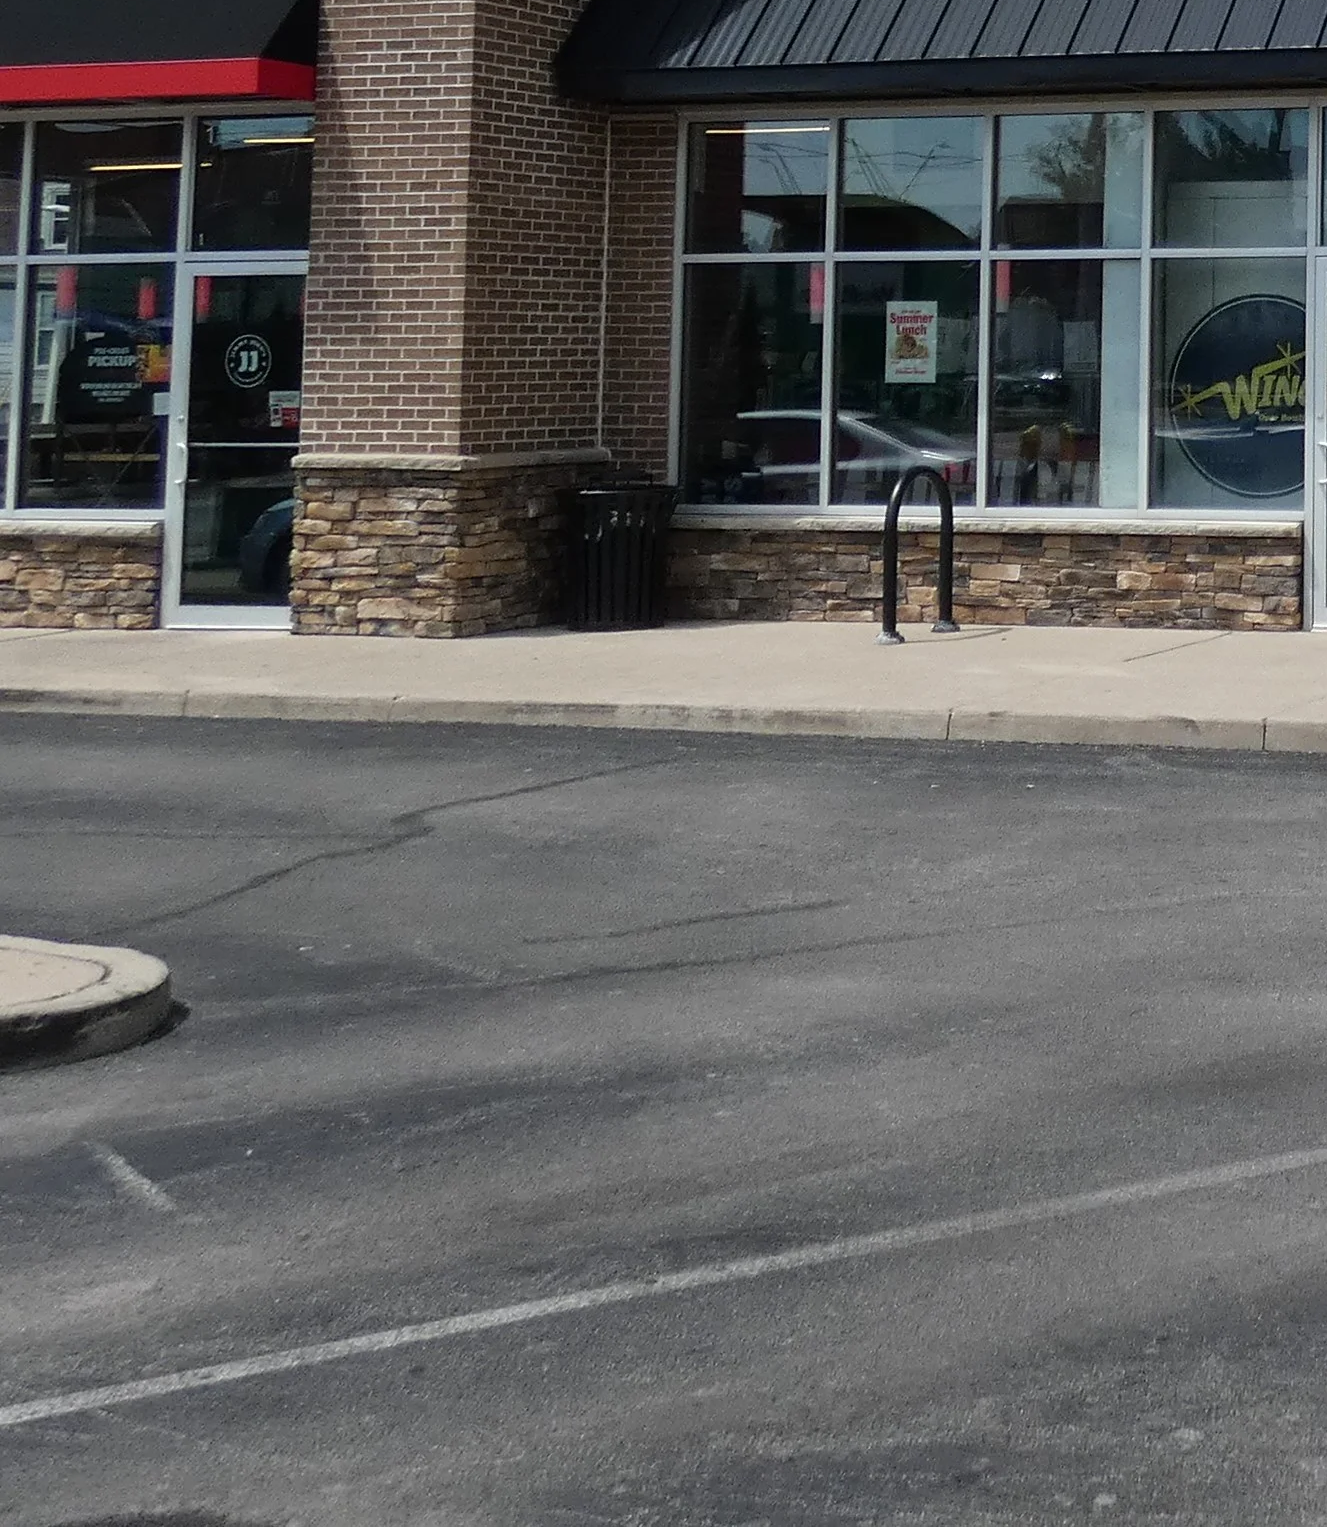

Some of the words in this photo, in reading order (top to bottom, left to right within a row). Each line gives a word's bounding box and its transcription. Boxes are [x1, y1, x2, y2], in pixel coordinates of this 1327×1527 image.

[889, 313, 933, 324] Summer
[896, 325, 927, 335] Lunch
[87, 355, 136, 367] PICKUP
[238, 351, 259, 372] JJ
